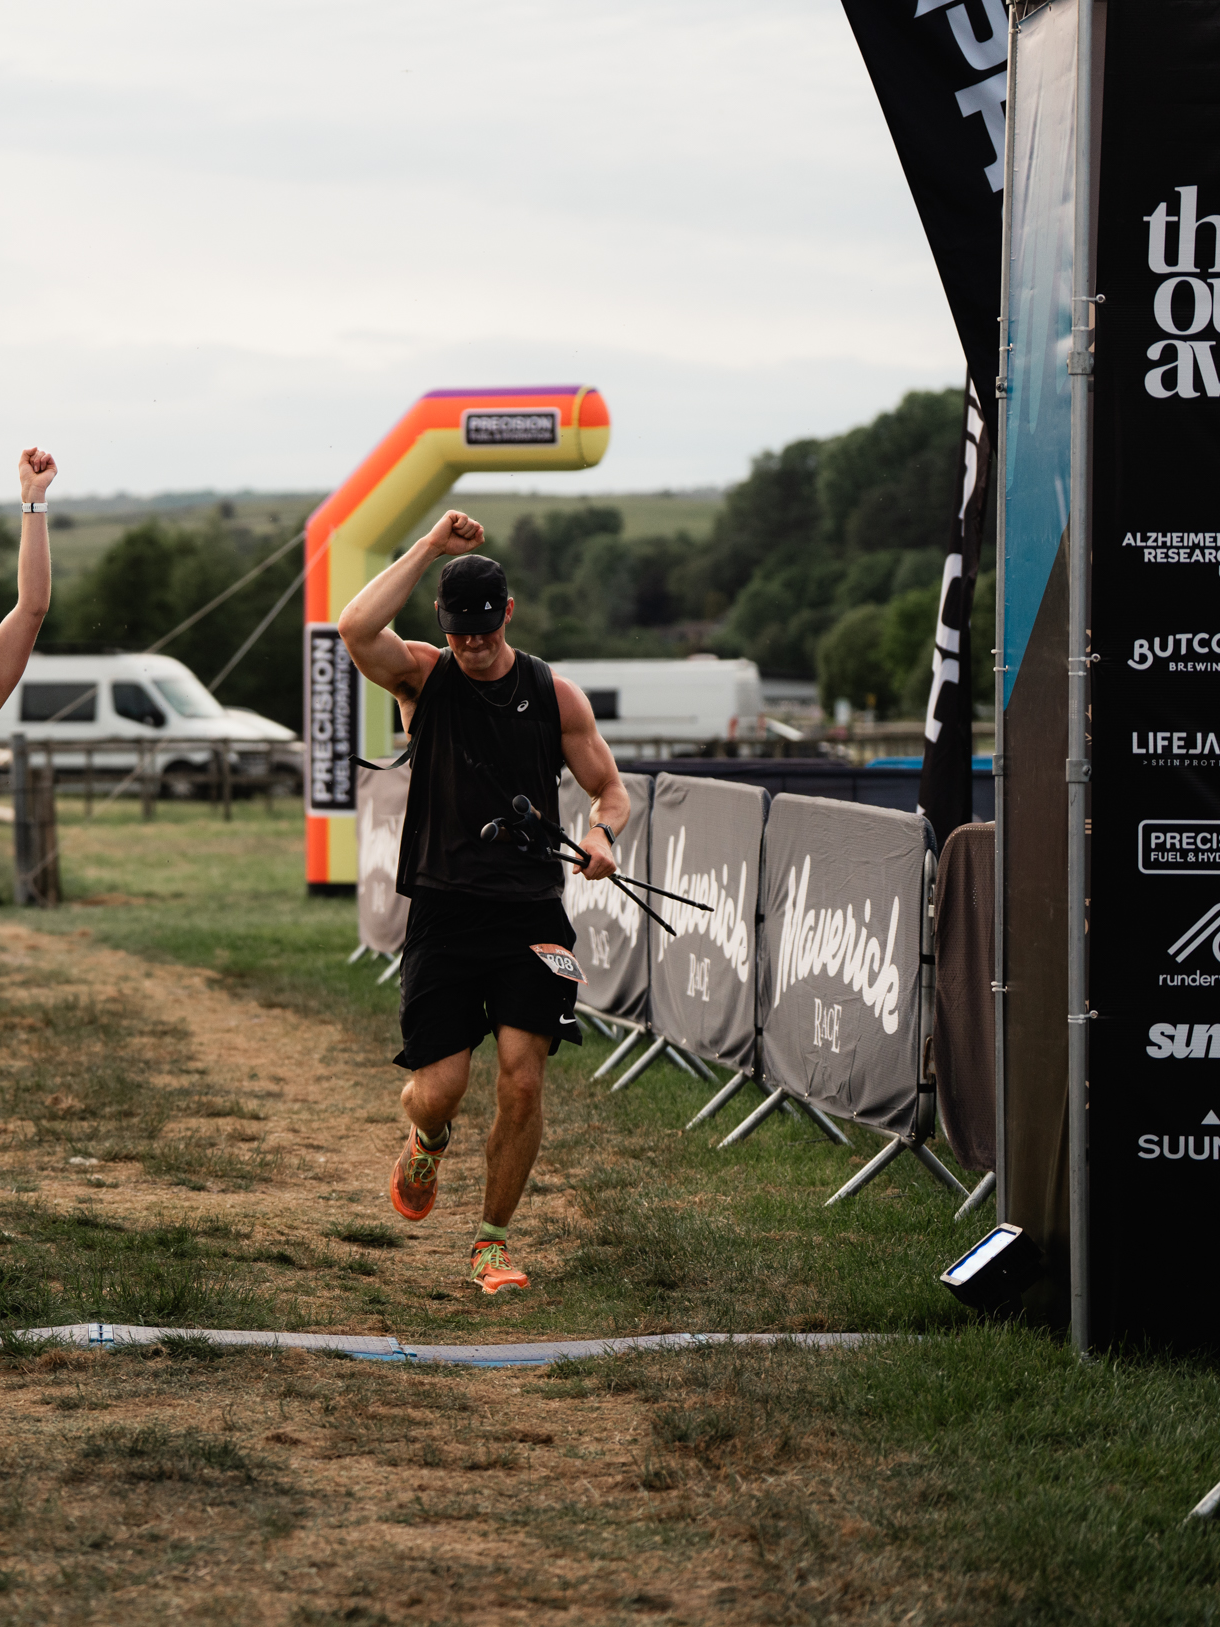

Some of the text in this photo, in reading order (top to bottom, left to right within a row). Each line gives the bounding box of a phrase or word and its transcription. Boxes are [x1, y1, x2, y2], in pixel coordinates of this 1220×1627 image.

[1143, 548, 1220, 563] RESEAR
[312, 637, 334, 802] PRECISION
[1184, 759, 1220, 767] PROT
[334, 757, 351, 802] FUEL
[1150, 832, 1220, 850] PRECI
[1150, 851, 1185, 862] FUEL
[1187, 851, 1196, 862] &
[658, 826, 750, 984] Maverick
[773, 854, 899, 1036] Maverick
[1159, 969, 1220, 986] runder
[813, 996, 843, 1055] RACE
